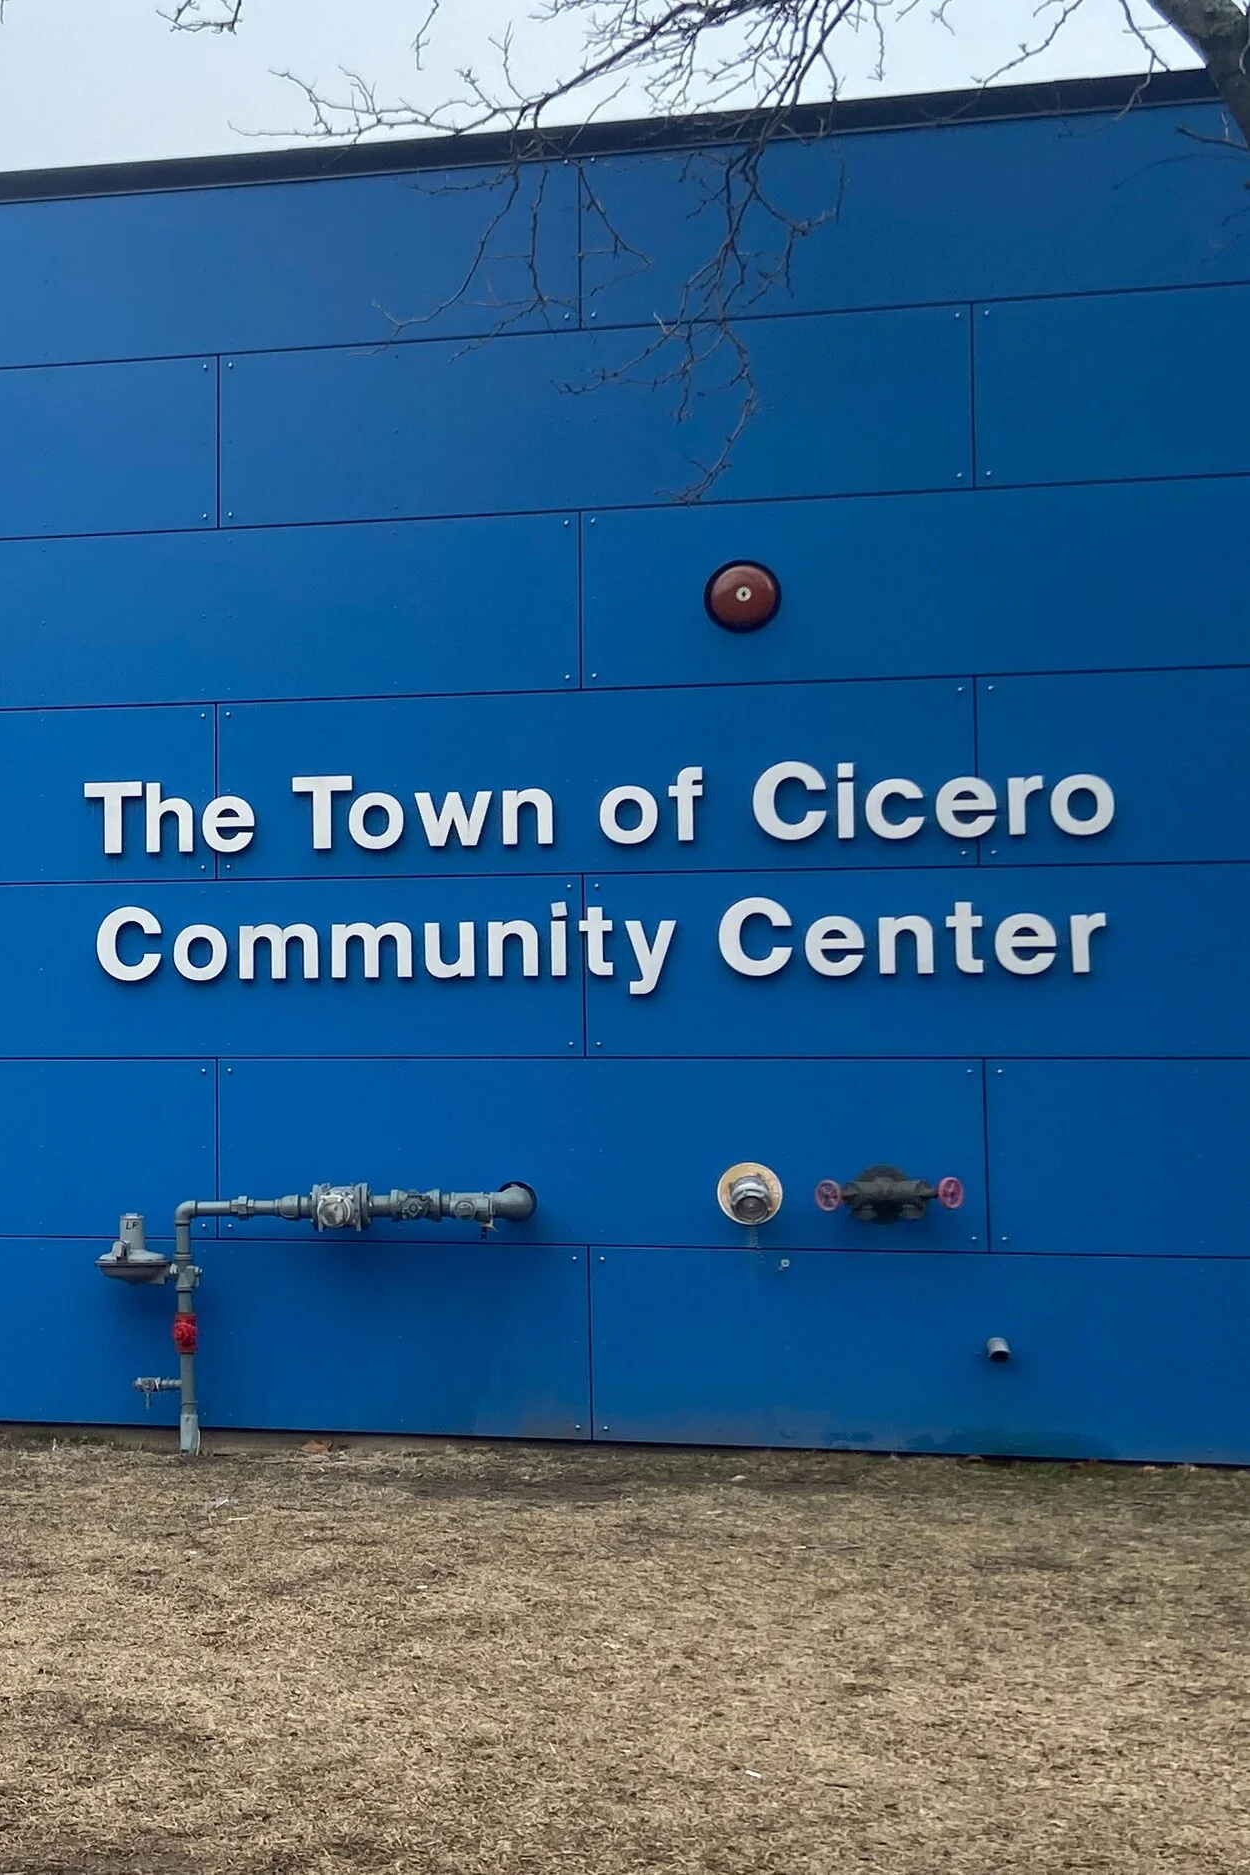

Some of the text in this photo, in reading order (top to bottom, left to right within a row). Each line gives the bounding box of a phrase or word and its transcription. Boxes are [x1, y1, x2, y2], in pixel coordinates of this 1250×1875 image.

[83, 760, 1116, 855] The Town of Cicero
[96, 896, 1107, 995] Community Center
